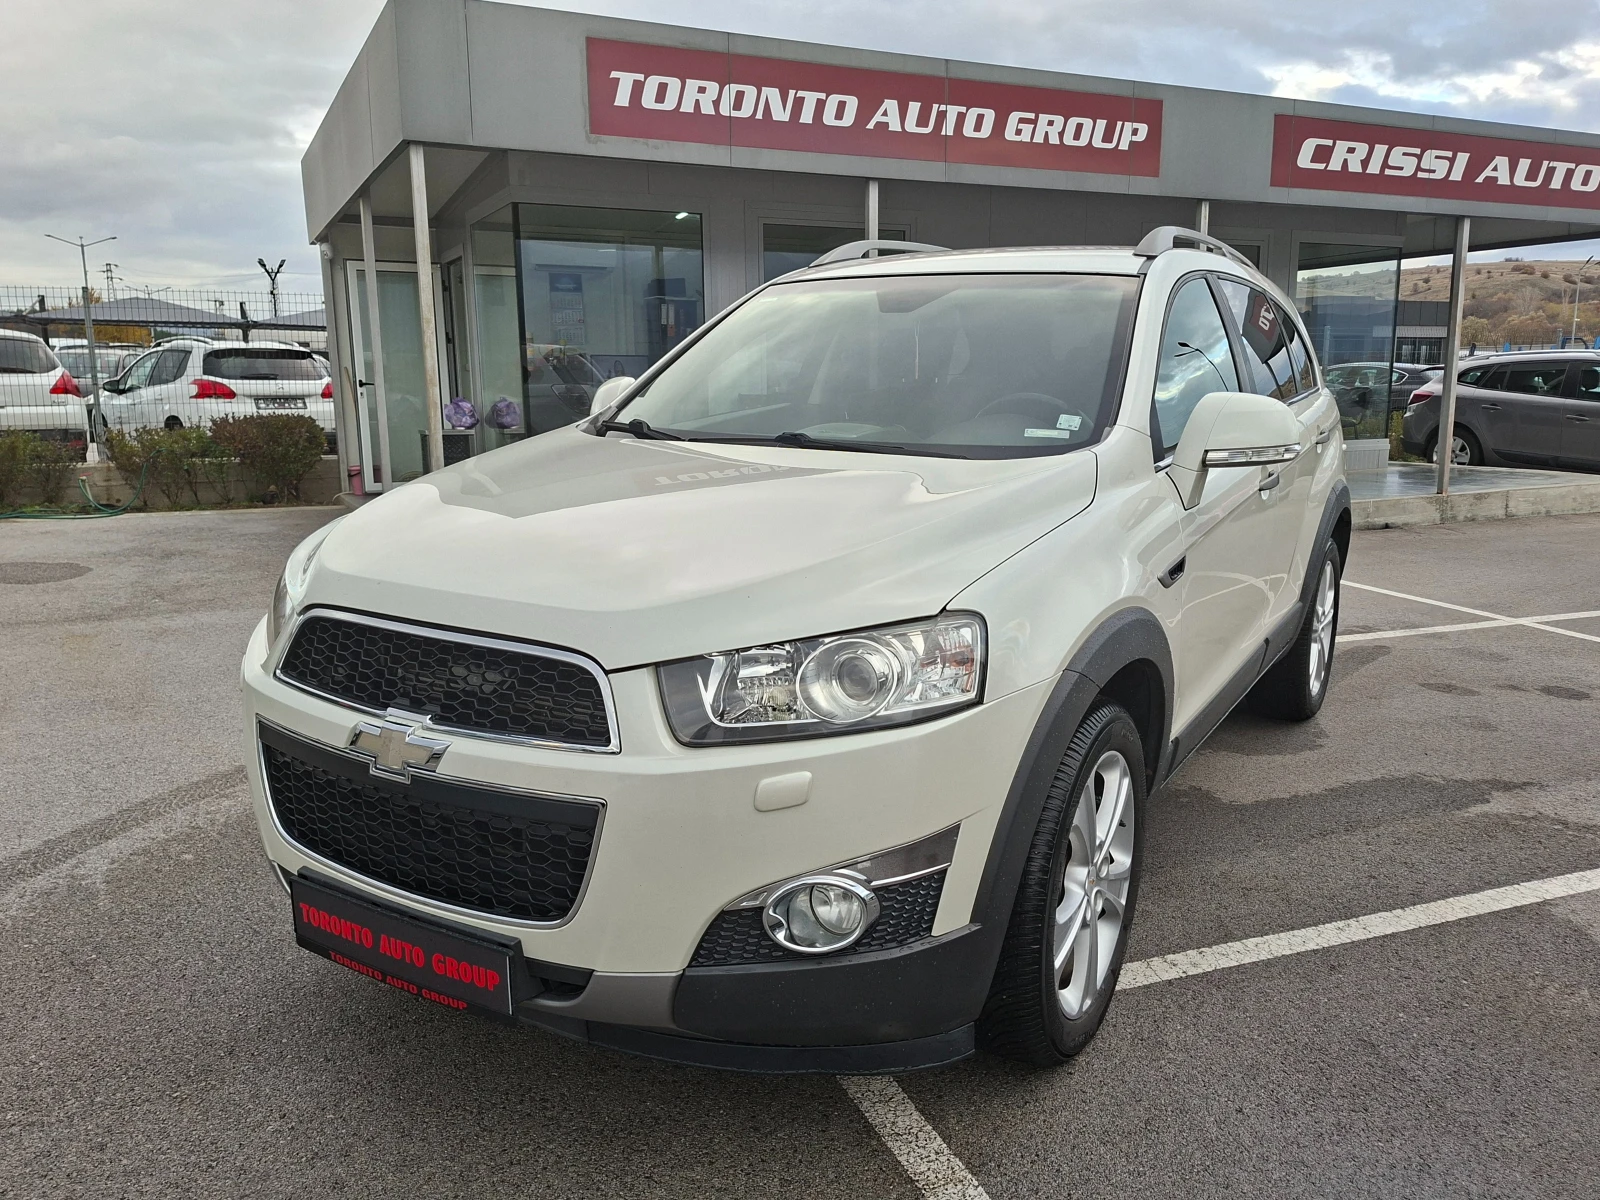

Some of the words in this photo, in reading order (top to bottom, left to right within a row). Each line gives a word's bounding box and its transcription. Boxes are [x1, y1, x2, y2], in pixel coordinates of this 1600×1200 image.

[609, 71, 859, 128] TORONTO
[866, 98, 995, 139] AUTO
[1004, 112, 1149, 151] GROUP
[1297, 138, 1471, 182] CRISSI
[1475, 155, 1600, 192] AUTO
[300, 903, 373, 949] TORONTO
[379, 934, 425, 968] AUTO
[432, 953, 500, 991] GROUP
[329, 951, 383, 981] TORONTO
[386, 976, 418, 994] AUTO
[421, 989, 468, 1010] GROUP
